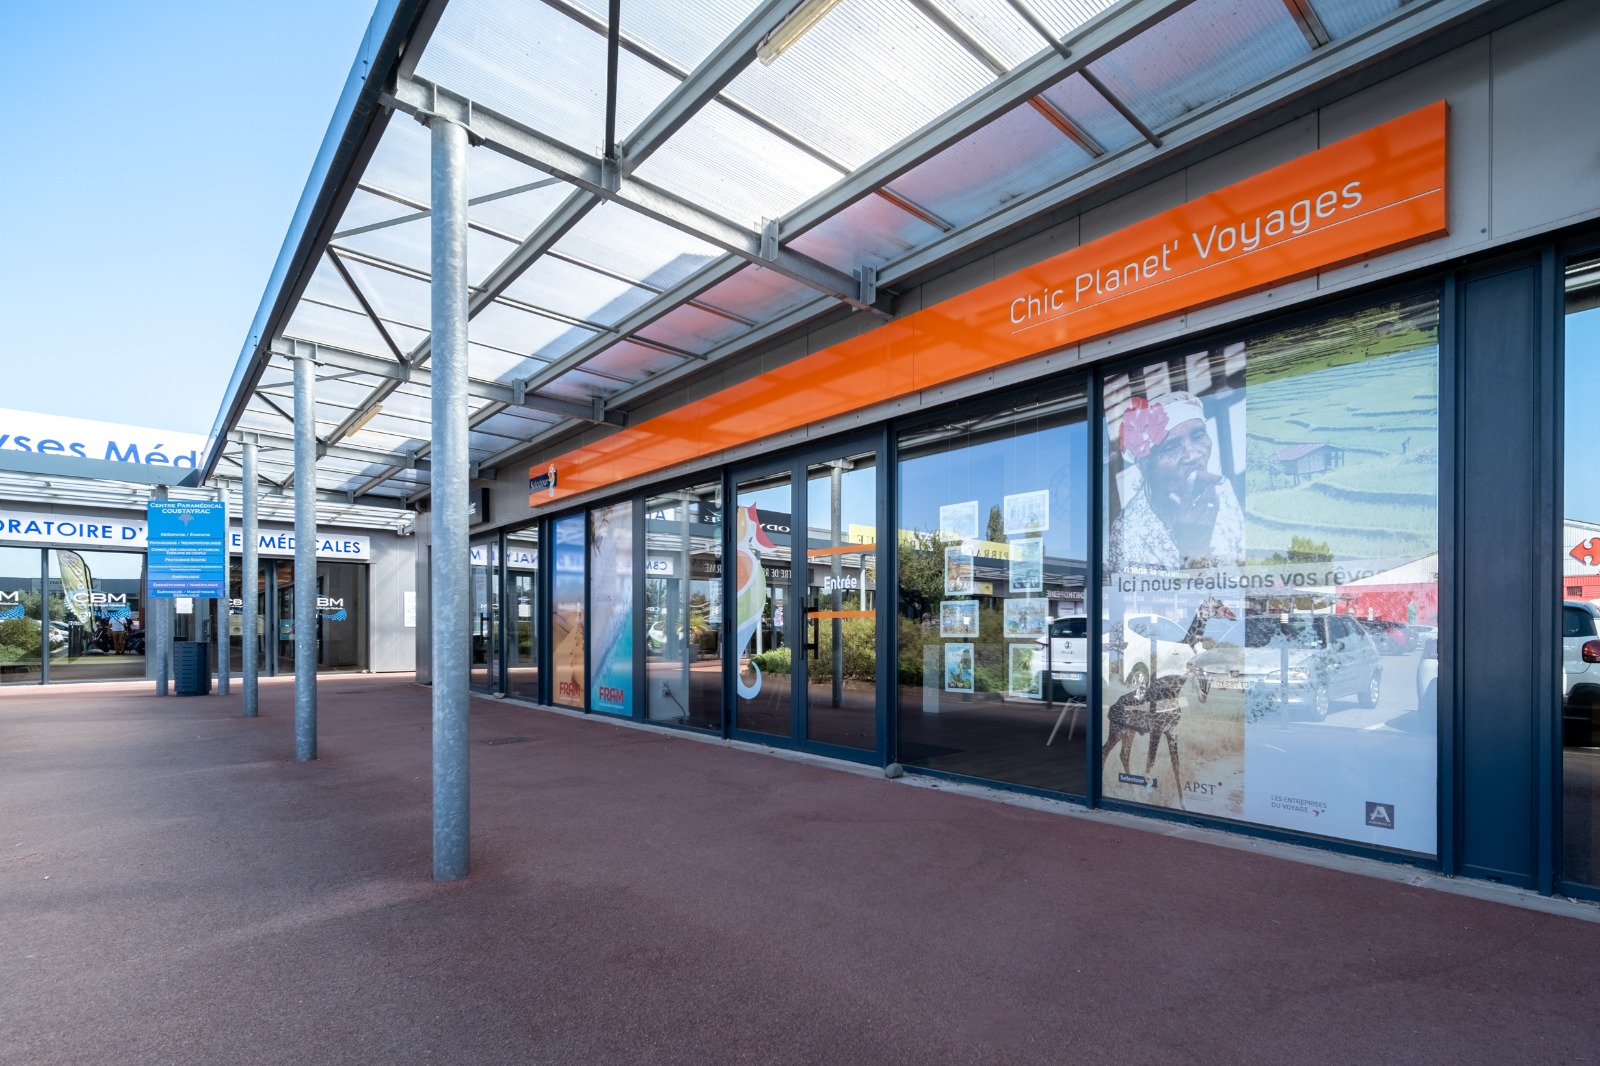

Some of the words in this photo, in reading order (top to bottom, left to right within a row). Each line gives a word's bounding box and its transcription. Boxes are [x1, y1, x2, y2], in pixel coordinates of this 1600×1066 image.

[1010, 288, 1064, 324] Chic
[1076, 239, 1179, 303] Planet'
[1191, 180, 1363, 259] Voyages
[823, 574, 858, 590] Entrée
[1118, 576, 1136, 593] Ici
[1141, 578, 1182, 592] nous
[1187, 572, 1275, 590] réalisons
[1280, 572, 1318, 587] vos
[73, 592, 127, 604] CBM
[560, 682, 581, 697] FRAM
[599, 686, 625, 703] FRAM
[1183, 781, 1217, 796] APST
[1271, 801, 1281, 809] DU
[1282, 803, 1309, 814] VOYAGE
[1284, 796, 1328, 809] ENTREPRISES
